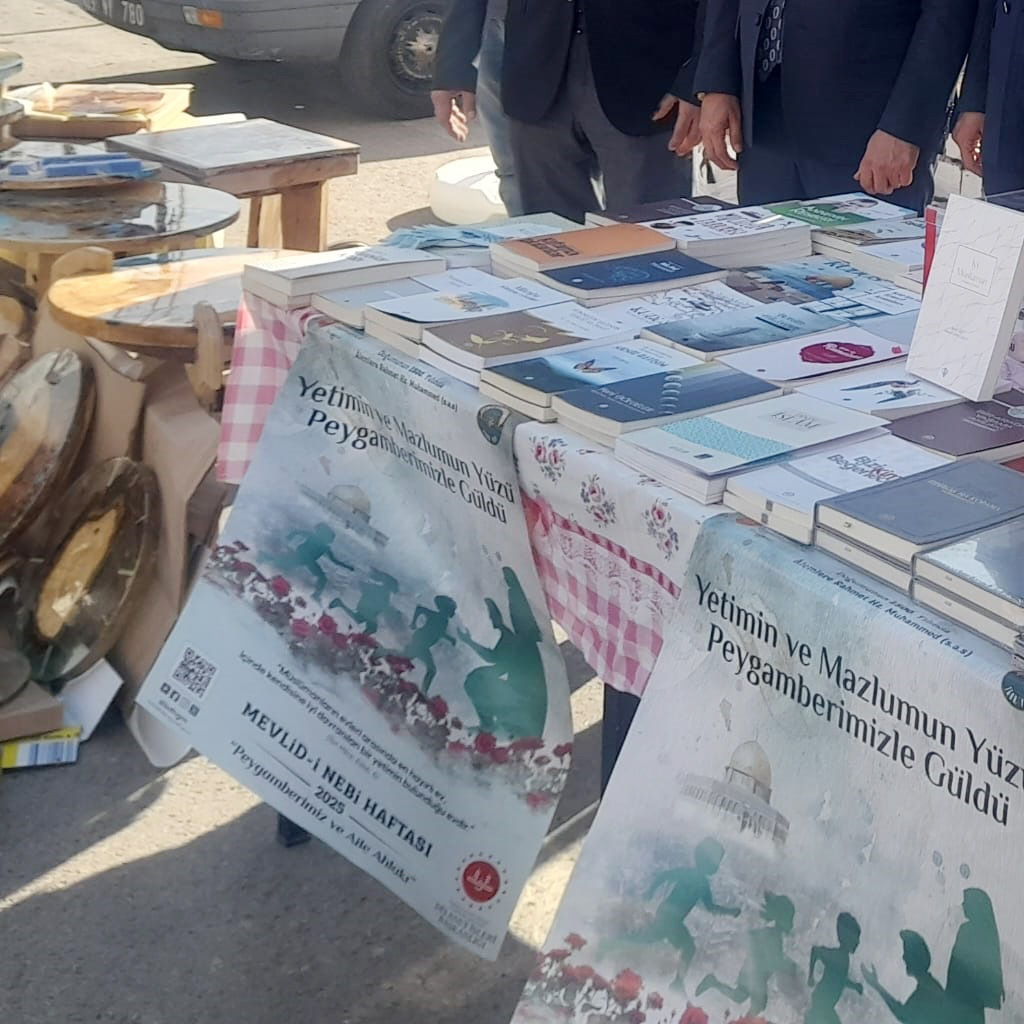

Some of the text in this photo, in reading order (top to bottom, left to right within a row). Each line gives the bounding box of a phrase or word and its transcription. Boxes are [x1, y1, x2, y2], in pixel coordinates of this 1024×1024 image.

[298, 375, 375, 420] Yetimin
[472, 461, 515, 504] Yüzü
[307, 408, 507, 524] Peygamberimizle Güldü
[695, 574, 778, 648] Yetimin
[785, 632, 812, 666] ve
[819, 646, 957, 750] Mazlumun
[884, 606, 942, 640] Muhammed
[707, 623, 1010, 826] Peygamberimizle Güldü
[314, 785, 347, 816] 2025
[363, 797, 434, 859] HAFTASI
